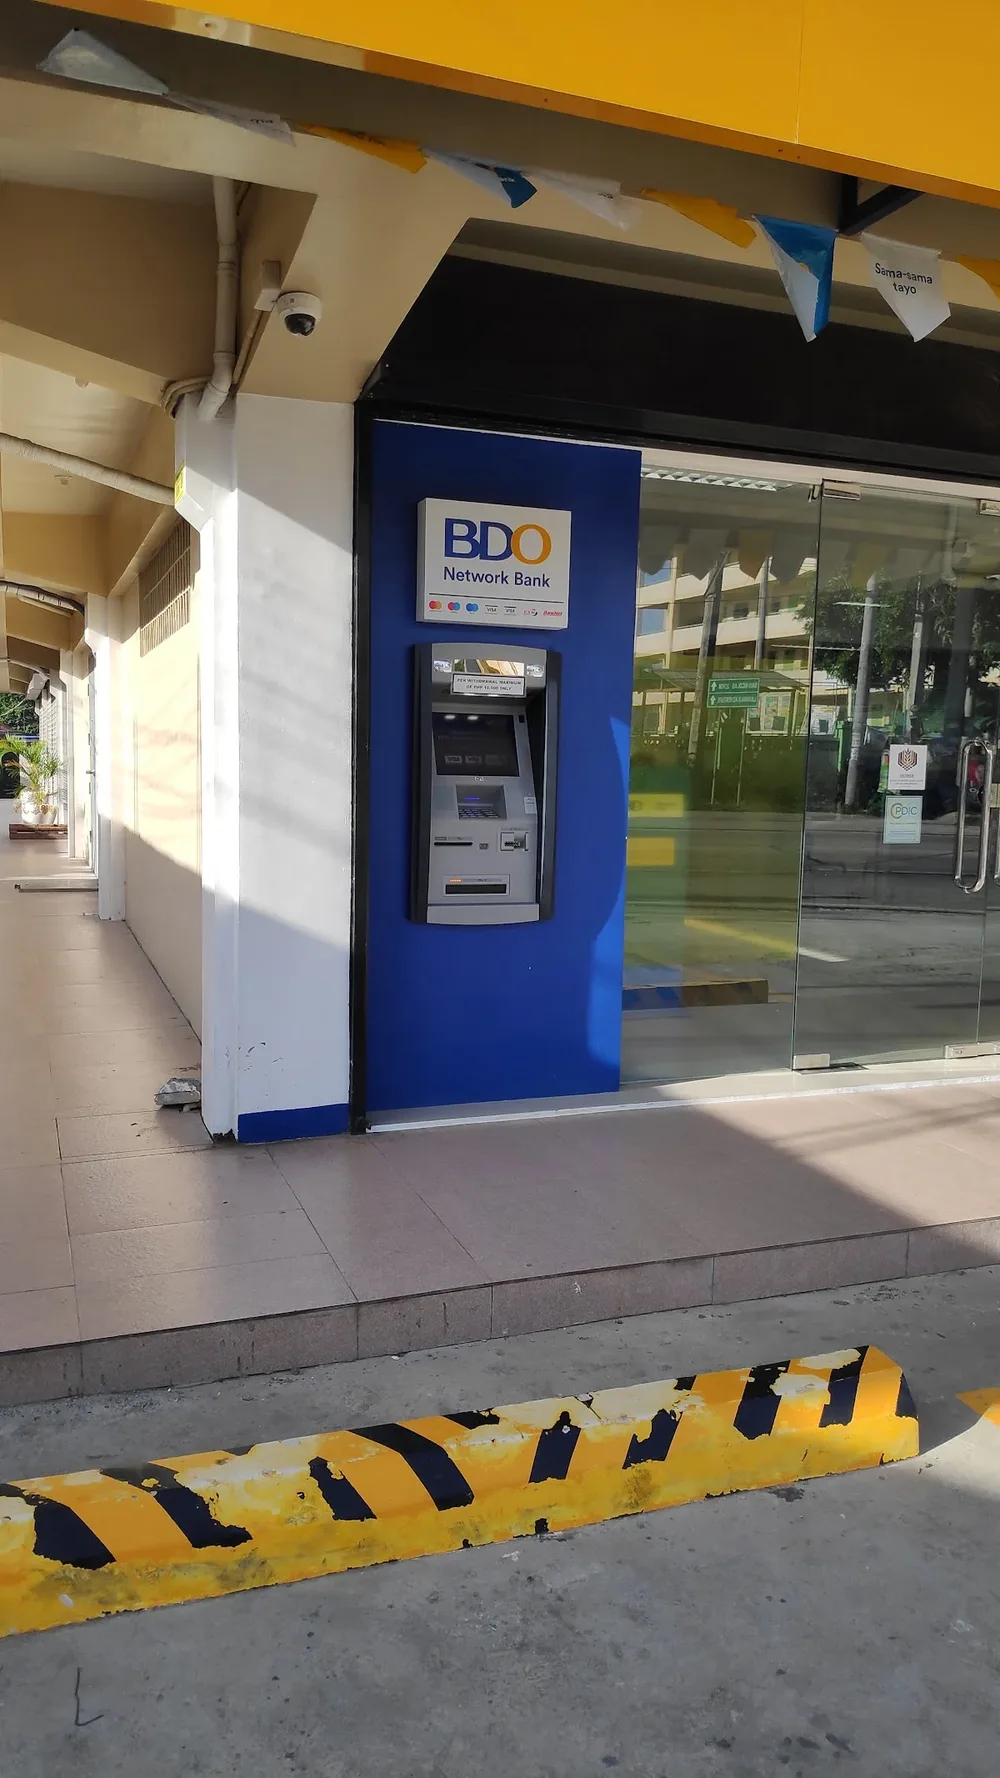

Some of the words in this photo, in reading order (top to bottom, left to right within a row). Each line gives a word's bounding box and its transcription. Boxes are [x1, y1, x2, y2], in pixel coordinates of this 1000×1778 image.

[874, 262, 933, 284] Sama-sama
[892, 282, 917, 295] tayo
[444, 518, 552, 565] BDO
[443, 566, 509, 585] Network
[514, 571, 550, 588] Bank
